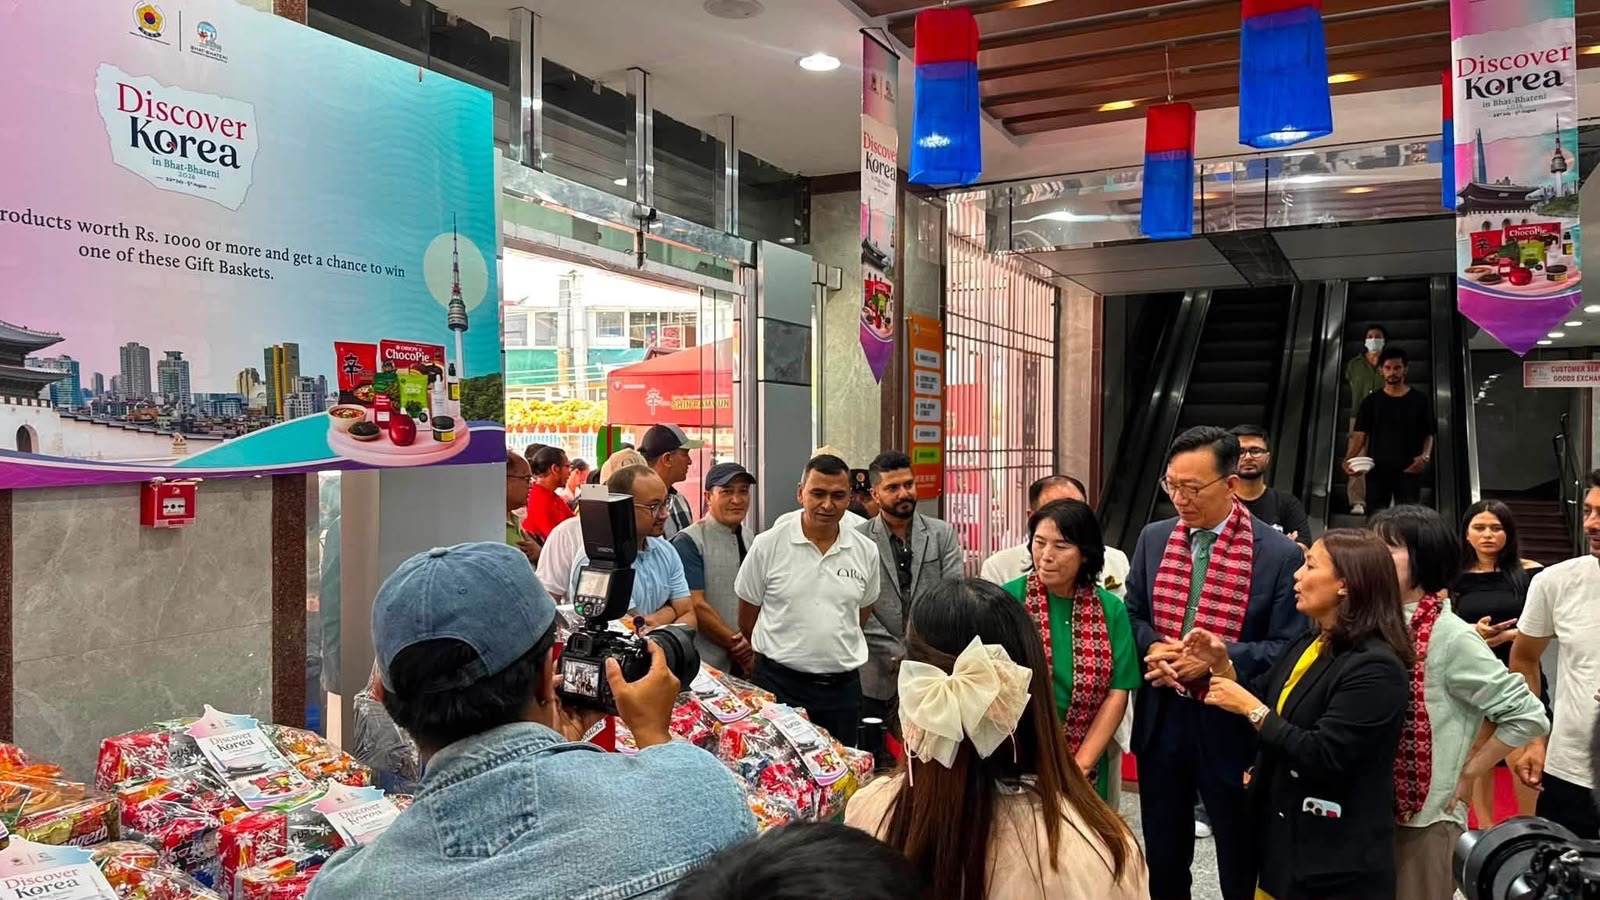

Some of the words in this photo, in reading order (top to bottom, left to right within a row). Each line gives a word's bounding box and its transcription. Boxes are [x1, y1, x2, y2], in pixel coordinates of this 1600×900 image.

[1456, 45, 1573, 78] Discover
[1465, 69, 1565, 100] Korea
[1493, 93, 1547, 107] Bhat-Bhateni
[116, 82, 247, 141] Discover
[129, 115, 241, 170] Korea
[863, 131, 897, 162] Discove
[152, 156, 162, 166] in
[164, 159, 220, 178] Bhat-Bhateni
[865, 151, 896, 182] Korea
[77, 220, 129, 239] worth
[135, 225, 159, 243] Rs.
[164, 233, 201, 249] 1000
[205, 240, 221, 252] or
[225, 242, 262, 257] more
[265, 248, 289, 262] and
[293, 252, 313, 267] get
[316, 256, 323, 266] a
[326, 255, 367, 273] chance
[370, 263, 382, 275] to
[385, 265, 406, 278] win
[78, 244, 111, 259] one
[116, 247, 135, 262] of
[138, 249, 180, 268] these
[185, 255, 215, 273] Gift
[219, 260, 274, 280] Baskets.
[385, 348, 430, 362] ChocoPie
[1551, 365, 1586, 373] CUSTOMER
[209, 732, 252, 746] Discover
[216, 739, 255, 752] Korea
[338, 803, 381, 820] Discover
[5, 868, 79, 890] Discover
[15, 878, 80, 899] Korea
